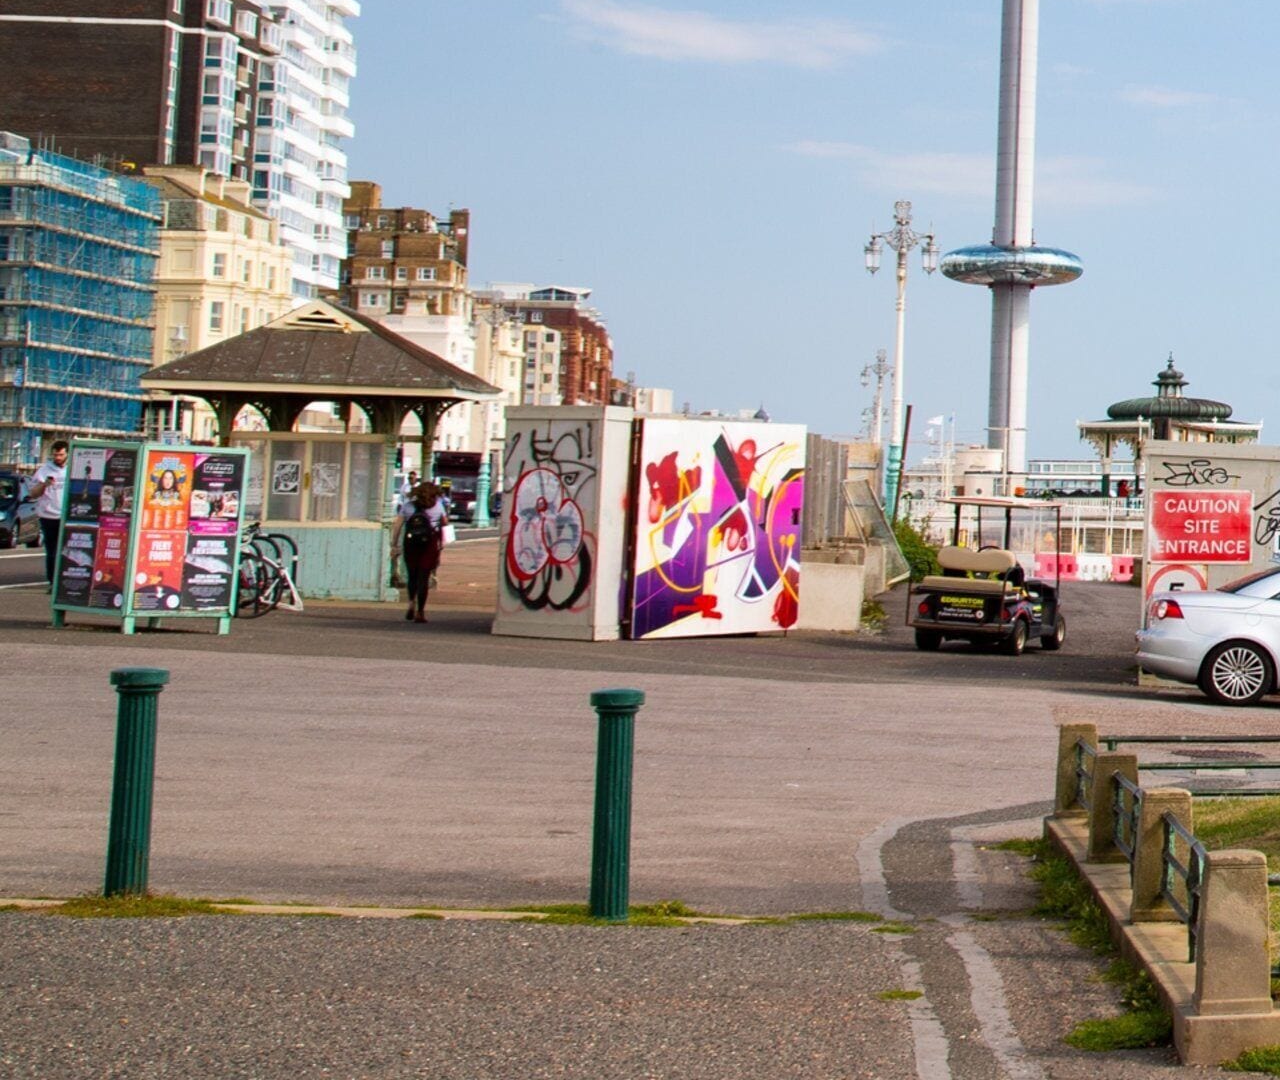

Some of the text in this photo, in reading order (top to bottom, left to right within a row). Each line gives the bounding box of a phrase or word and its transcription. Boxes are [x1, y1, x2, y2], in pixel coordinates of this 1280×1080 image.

[1164, 499, 1240, 513] CAUTION
[1183, 520, 1219, 533] SITE
[1158, 540, 1246, 554] ENTRANCE
[941, 596, 984, 604] EDBURTON
